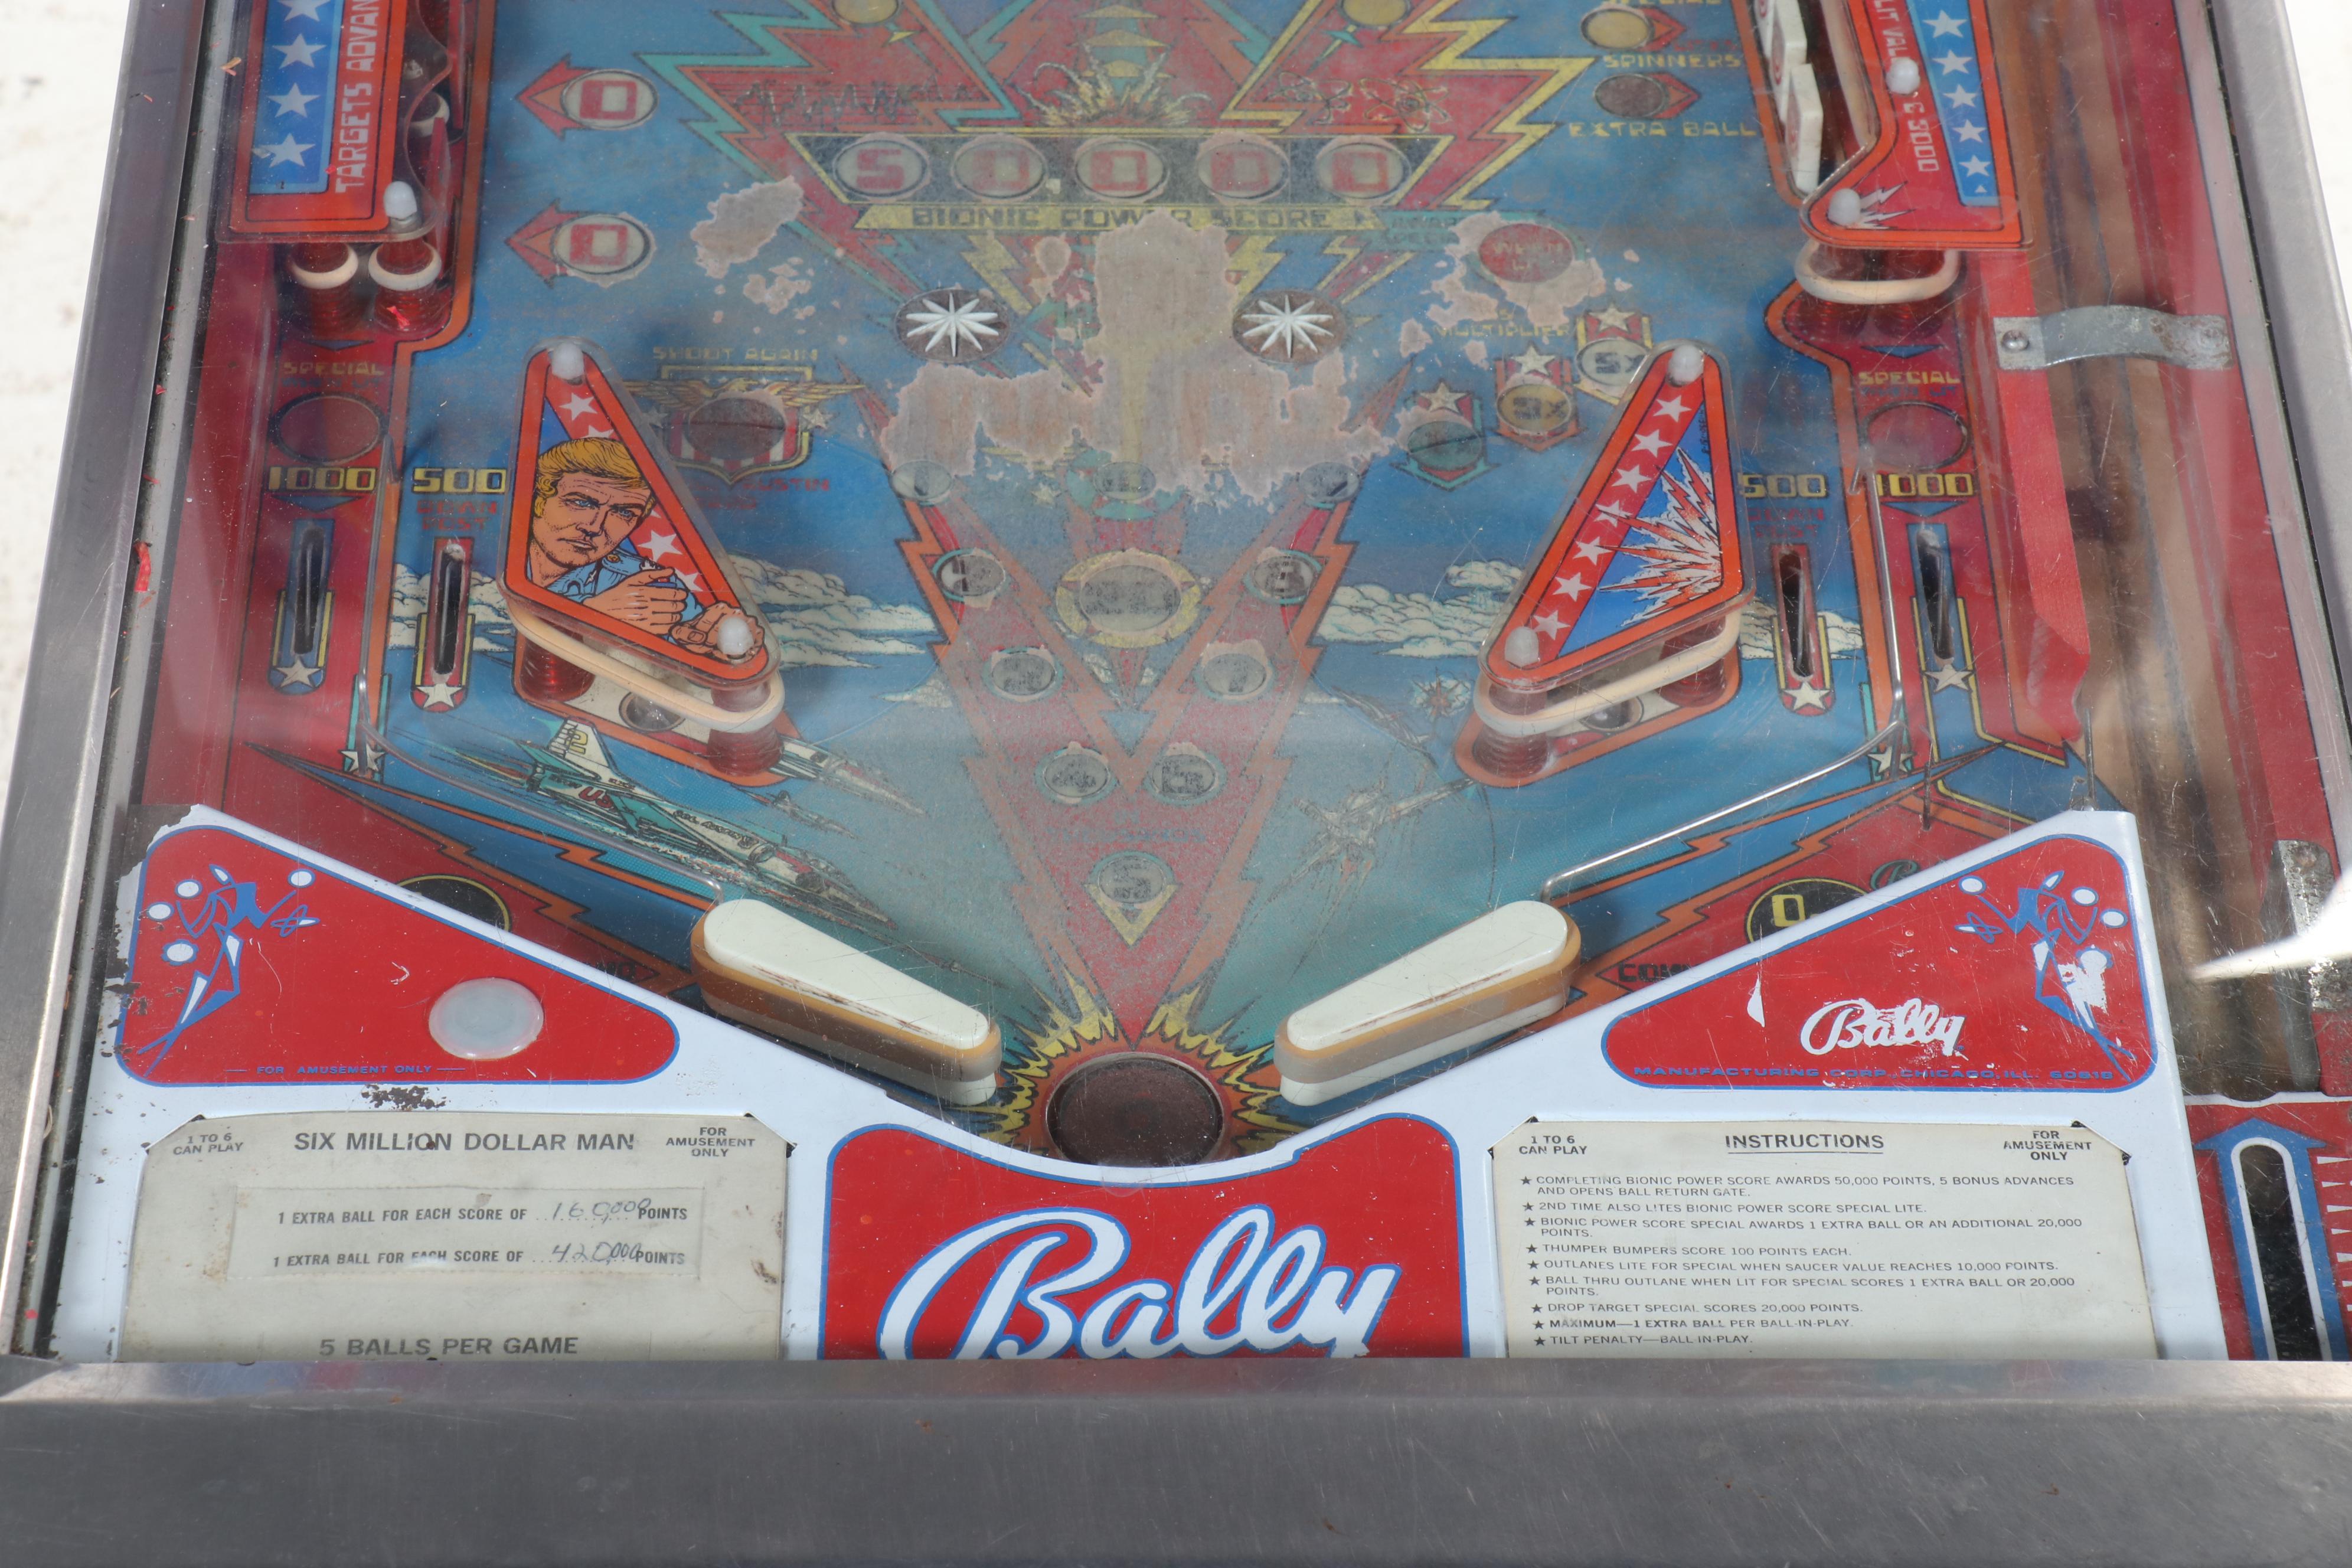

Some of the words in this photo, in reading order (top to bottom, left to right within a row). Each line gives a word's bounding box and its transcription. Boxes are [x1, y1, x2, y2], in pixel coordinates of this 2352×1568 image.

[1602, 54, 1742, 68] SPINNERS
[1569, 122, 1667, 138] EXTRA
[1683, 122, 1758, 137] BALL
[335, 83, 373, 194] TARGETS
[912, 207, 1040, 228] BIONIC
[1063, 207, 1191, 227] POWR
[1210, 208, 1330, 228] SCORE
[652, 346, 733, 360] SHOOT
[745, 348, 818, 361] AGAIN
[283, 361, 384, 375] SPECIAL
[1858, 371, 1961, 385] SPECIAL
[267, 466, 377, 492] 1000
[412, 467, 507, 494] 500
[1739, 473, 1828, 498] 500
[1800, 998, 1966, 1057] Bally
[256, 1066, 284, 1074] FOR
[297, 1066, 388, 1074] AMUSEMENT
[394, 1065, 432, 1073] ONLY
[1634, 1066, 1819, 1077] MANUFACTURING
[700, 1126, 727, 1136] FOR
[2033, 1130, 2060, 1139] FOR
[187, 1135, 194, 1144] 1
[200, 1133, 220, 1143] TO
[224, 1132, 232, 1142] 6
[295, 1132, 336, 1151] SIX
[346, 1132, 452, 1151] MILLION
[464, 1133, 566, 1151] DOLLAR
[576, 1133, 635, 1151] MAN
[665, 1137, 756, 1147] AMUSEMENT
[1531, 1135, 1537, 1144] 1
[1543, 1135, 1562, 1144] TO
[1567, 1135, 1575, 1144] 6
[1725, 1134, 1884, 1149] INSTRUCTIONS
[172, 1144, 202, 1156] CAN
[208, 1141, 244, 1154] PLAY
[1518, 1146, 1547, 1155] CAN
[1553, 1146, 1587, 1155] PLAY
[2003, 1141, 2092, 1150] AMUSEMENT
[691, 1148, 729, 1158] ONLY
[2030, 1151, 2068, 1161] ONLY
[1536, 1176, 1621, 1185] COMPLETING
[1626, 1176, 1672, 1185] BIONIC
[1677, 1176, 1723, 1185] POWER
[1727, 1176, 1772, 1185] SCORE
[1775, 1175, 1831, 1185] AWARDS
[1834, 1176, 1879, 1186] 50,000
[1883, 1176, 1935, 1186] POINTS,
[1939, 1176, 1948, 1185] 5
[1952, 1176, 2000, 1185] BONUS
[2004, 1177, 2074, 1185] ADVANCES
[1537, 1187, 1566, 1195] AND
[1569, 1187, 1613, 1196] OPENS
[1618, 1187, 1651, 1196] BALL
[1655, 1187, 1709, 1197] RETURN
[1713, 1188, 1750, 1197] GATE.
[638, 1207, 688, 1220] POINTS
[1539, 1202, 1566, 1210] 2ND
[1570, 1202, 1603, 1211] TIME
[1607, 1203, 1641, 1212] ALSO
[1645, 1203, 1682, 1213] LITES
[1685, 1204, 1733, 1213] BIONIC
[1737, 1204, 1783, 1213] POWER
[1788, 1204, 1832, 1213] SCORE
[1836, 1204, 1892, 1213] SPECIAL
[1894, 1204, 1927, 1213] LITE.
[277, 1211, 285, 1224] 1
[292, 1211, 336, 1224] EXTRA
[341, 1210, 375, 1223] BALL
[382, 1209, 409, 1222] FOR
[415, 1208, 451, 1221] EACH
[458, 1208, 503, 1221] SCORE
[509, 1208, 527, 1220] OF
[1541, 1217, 1587, 1226] BIONIC
[1592, 1218, 1637, 1227] POWER
[1642, 1220, 1686, 1229] SCORE
[1690, 1220, 1745, 1229] SPECIAL
[1749, 1220, 1804, 1230] AWARDS
[1809, 1221, 1816, 1230] 1
[1821, 1220, 1864, 1229] EXTRA
[1868, 1220, 1902, 1229] BALL
[1905, 1220, 1924, 1229] OR
[1929, 1220, 1947, 1229] AN
[1952, 1219, 2034, 1229] ADDITIONAL
[2037, 1219, 2082, 1228] 20,000
[1541, 1227, 1593, 1237] POINTS.
[1542, 1244, 1607, 1254] THUMPER
[1613, 1245, 1677, 1255] BUMPERS
[1681, 1246, 1726, 1255] SCORE
[1732, 1247, 1755, 1256] 100
[1759, 1247, 1808, 1256] POINTS
[1812, 1247, 1852, 1256] EACH.
[273, 1256, 279, 1268] 1
[287, 1255, 330, 1267] EXTRA
[337, 1253, 371, 1265] BALL
[377, 1252, 404, 1264] FOR
[453, 1250, 499, 1262] SCORE
[507, 1250, 524, 1262] OF
[635, 1252, 685, 1265] POINTS
[1544, 1260, 1615, 1270] OUTLANES
[1619, 1262, 1647, 1270] LITE
[1651, 1262, 1677, 1270] FOR
[1682, 1262, 1737, 1271] SPECIAL
[1740, 1263, 1781, 1271] WHEN
[1785, 1263, 1838, 1272] SAUCER
[1842, 1263, 1886, 1272] VALUE
[1890, 1262, 1952, 1272] REACHES
[1957, 1262, 2001, 1272] 10,000
[2005, 1261, 2059, 1270] POINTS.
[877, 1203, 1402, 1360] Bally
[1546, 1276, 1579, 1285] BALL
[1582, 1276, 1620, 1285] THRU
[1624, 1277, 1687, 1286] OUTLANE
[1691, 1278, 1731, 1286] WHEN
[1736, 1278, 1756, 1286] LIT
[1761, 1278, 1788, 1287] FOR
[1792, 1278, 1847, 1287] SPECIAL
[1851, 1278, 1904, 1287] SCORES
[1909, 1278, 1916, 1287] 1
[1922, 1278, 1965, 1288] EXTRA
[1969, 1278, 2003, 1287] BALL
[2007, 1278, 2027, 1287] OR
[2030, 1277, 2075, 1288] 20,000
[1546, 1286, 1599, 1296] POINTS.
[1547, 1303, 1585, 1312] DROP
[1588, 1304, 1641, 1312] TARGET
[1645, 1304, 1700, 1313] SPECIAL
[1703, 1304, 1757, 1312] SCORES
[1761, 1304, 1806, 1313] 20,000
[1810, 1304, 1863, 1312] POINTS.
[319, 1338, 335, 1356] 5
[347, 1338, 431, 1356] BALLS
[442, 1337, 493, 1355] PER
[503, 1337, 579, 1355] GAME
